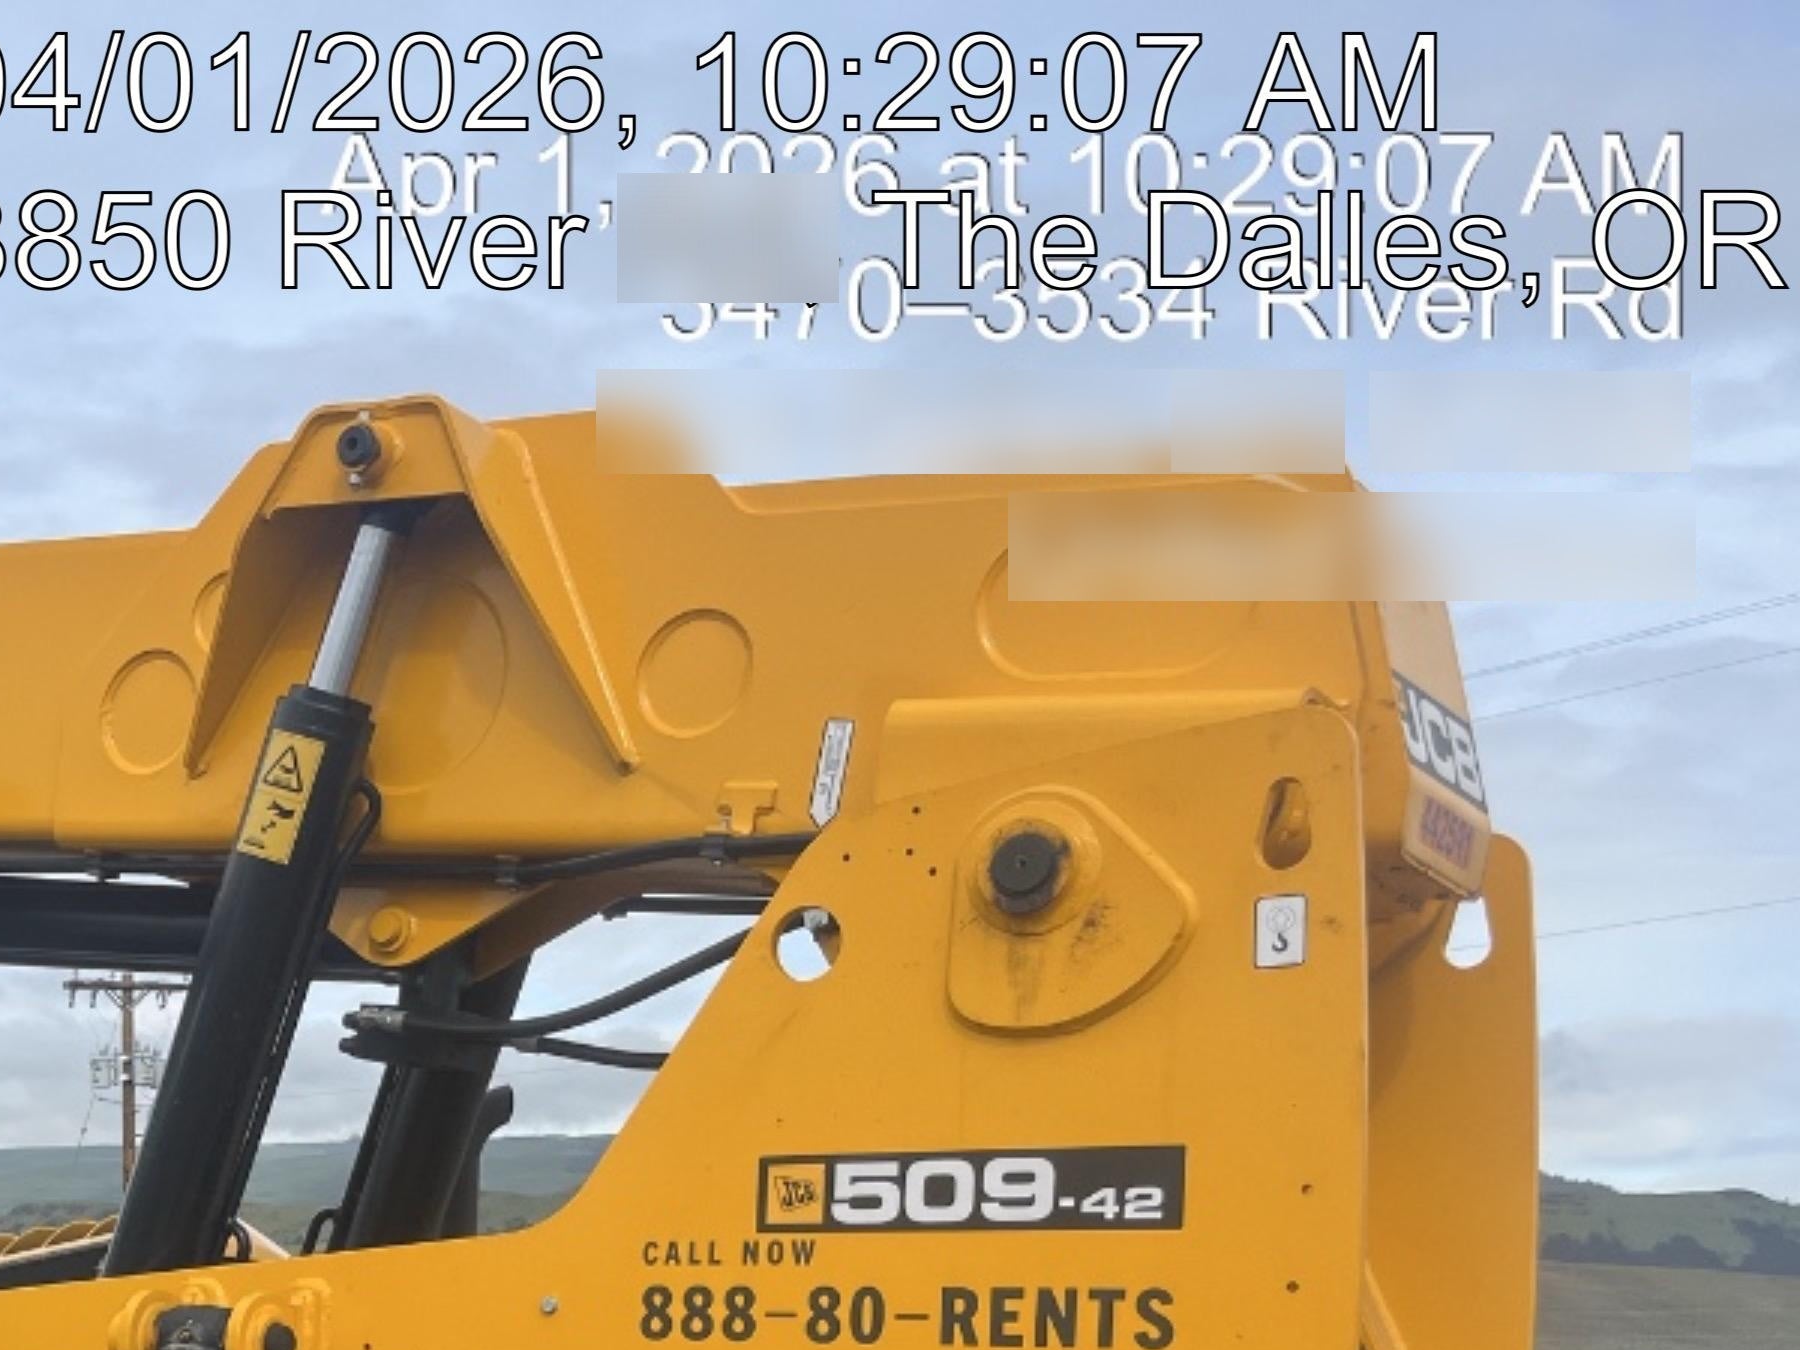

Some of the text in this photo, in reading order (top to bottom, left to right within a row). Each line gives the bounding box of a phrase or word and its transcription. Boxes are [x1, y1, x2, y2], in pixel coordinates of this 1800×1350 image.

[1404, 688, 1482, 797] JCB
[830, 1156, 1164, 1224] 509-42
[642, 1239, 818, 1267] CALL NOW
[640, 1284, 1176, 1350] 888-80-RENTS
